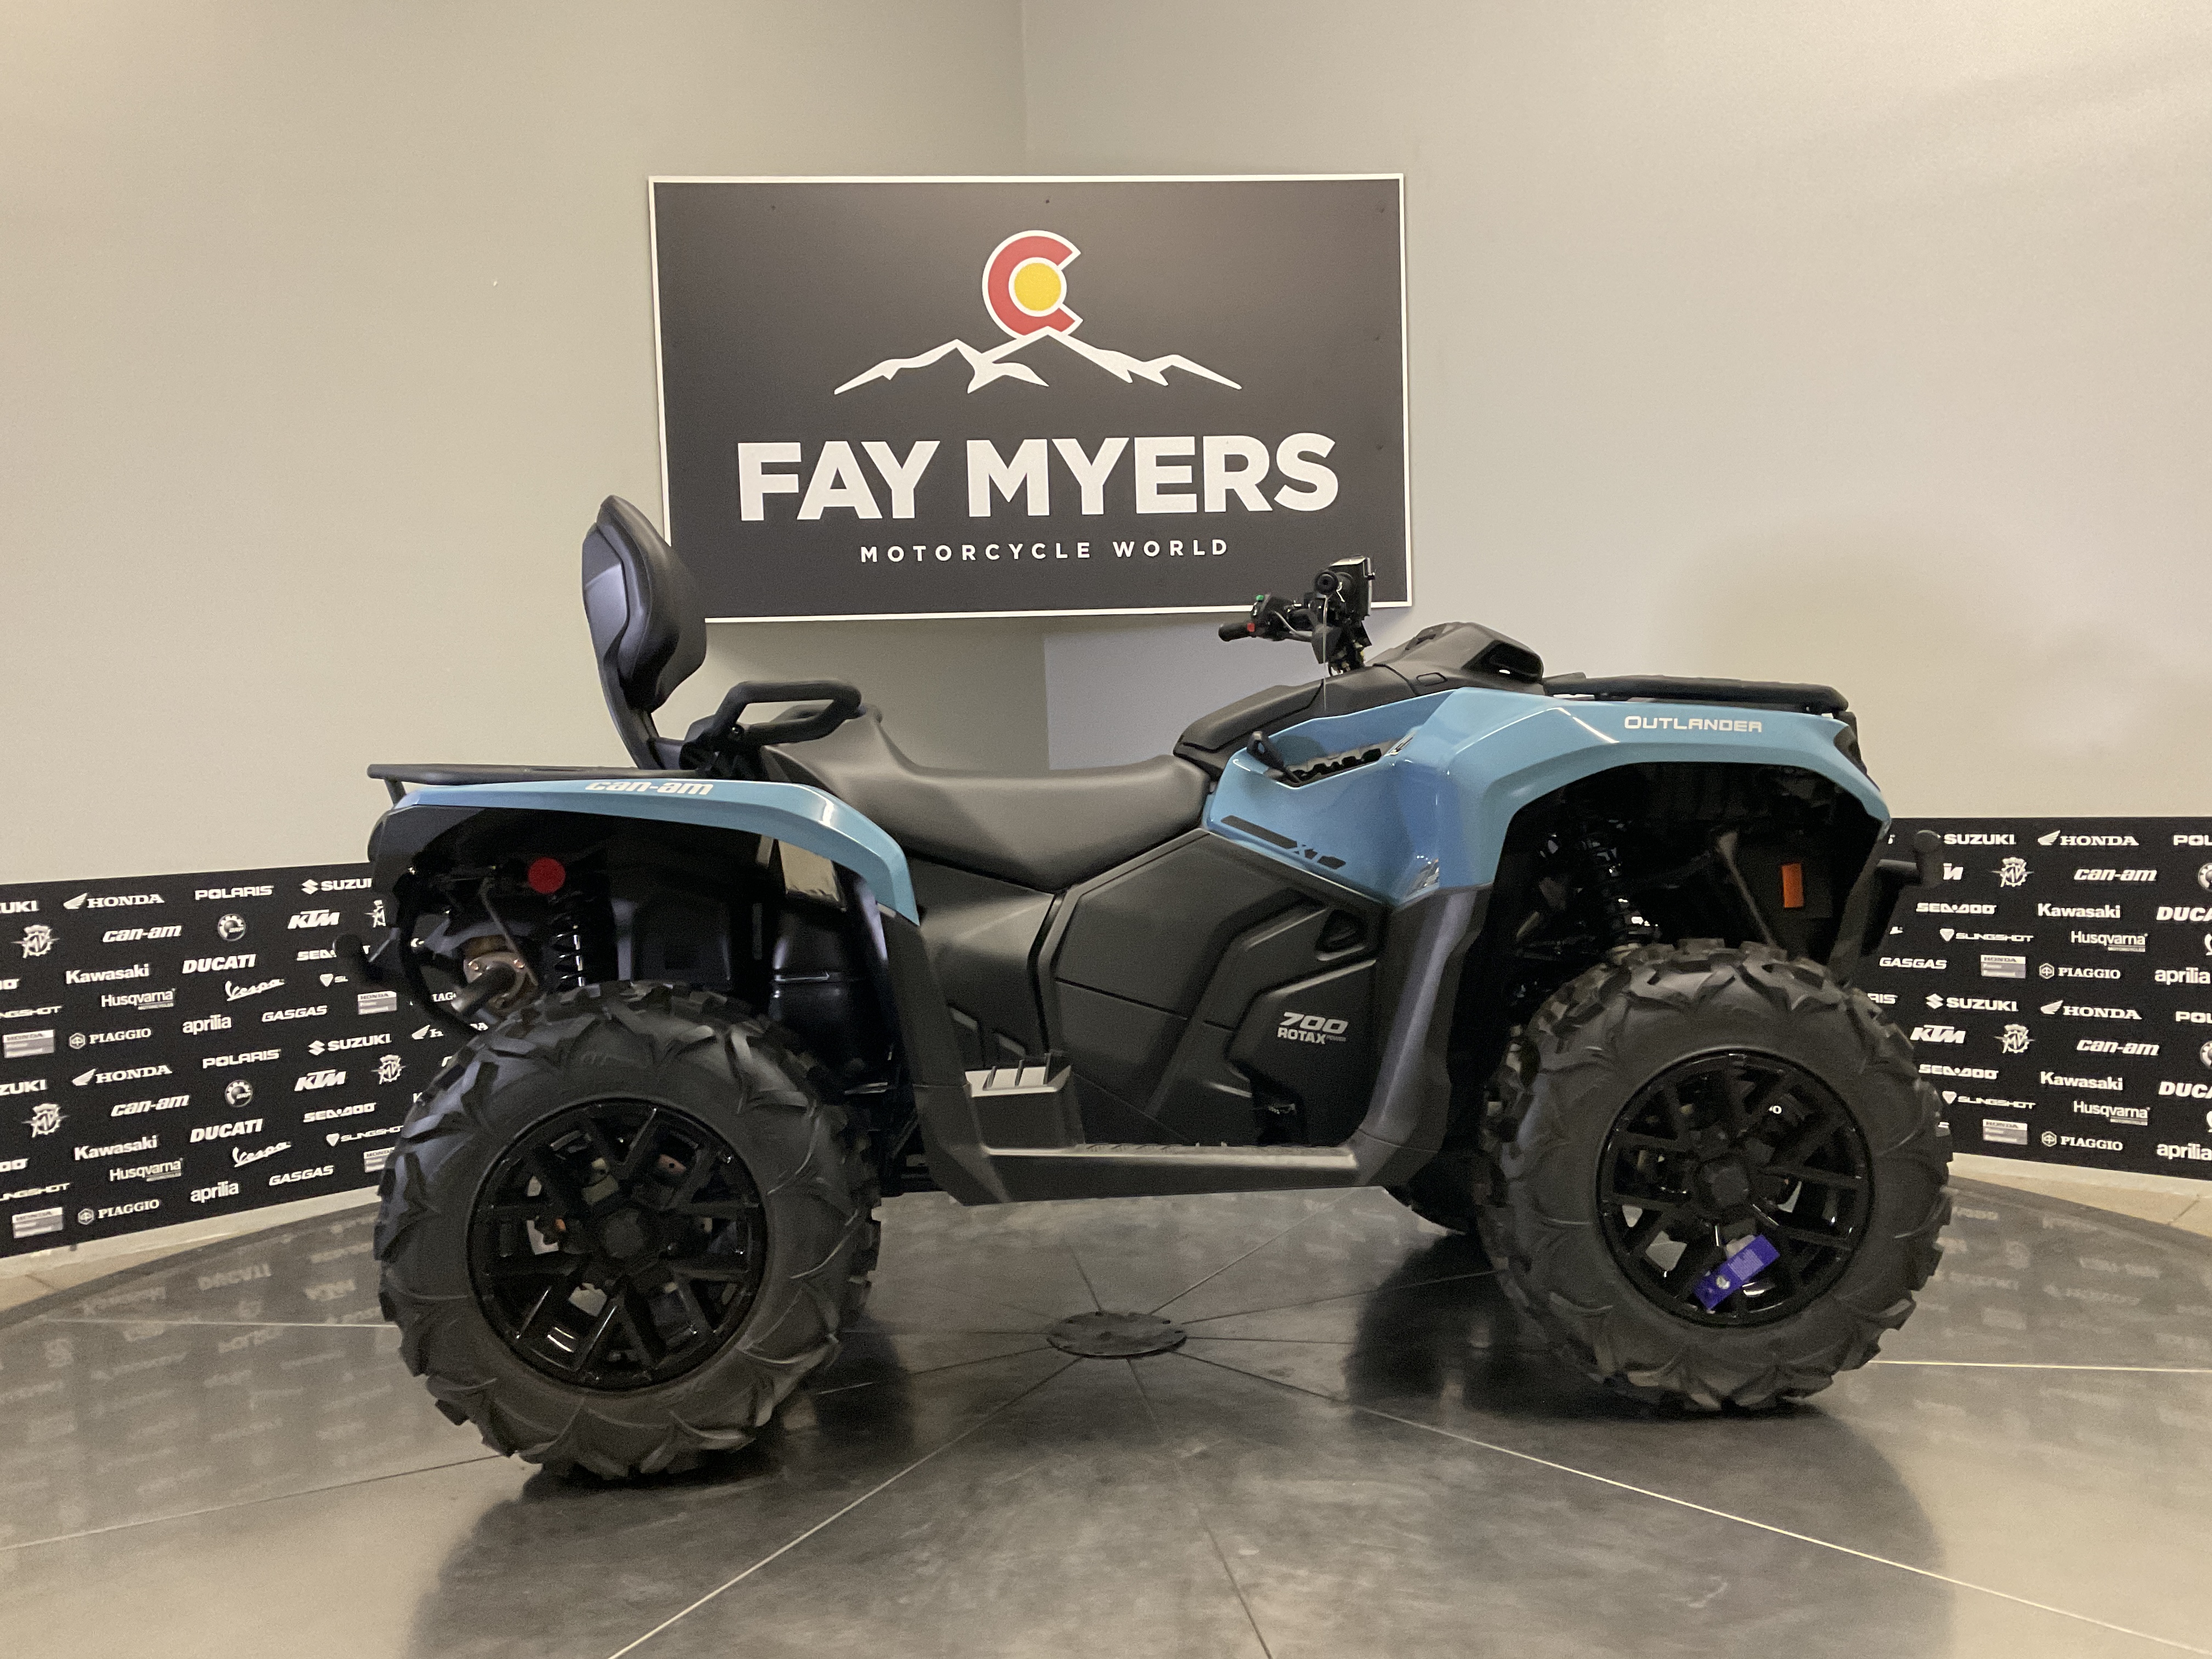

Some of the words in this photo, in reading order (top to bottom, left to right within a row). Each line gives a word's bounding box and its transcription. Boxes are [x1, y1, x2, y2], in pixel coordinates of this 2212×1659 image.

[738, 441, 940, 521] FAY
[967, 433, 1338, 517] MYERS
[861, 543, 1090, 562] MOTORCYCLE
[1113, 539, 1226, 557] WORLD
[585, 782, 713, 795] can-am
[1944, 834, 2016, 844] SUZUKI
[2060, 836, 2139, 845] HONDA
[2074, 869, 2157, 881] can-am
[195, 885, 274, 900] POLARIS
[321, 878, 373, 891] SUZU
[0, 901, 39, 913] UKI
[88, 894, 165, 908] HONDA
[2038, 903, 2120, 918] Kawasaki
[288, 910, 340, 929] KTM
[103, 926, 182, 942] can-am
[1956, 933, 2034, 941] SLINGSHOT
[2070, 930, 2146, 946] Husqvarna
[182, 954, 256, 973] DUCATI
[1880, 957, 1947, 969] GASGAS
[66, 963, 149, 984] Kawasaki
[2058, 968, 2120, 979] PIAGGIO
[2155, 967, 2210, 985] aprilia
[101, 990, 174, 1007] Husqvarna
[1946, 997, 2018, 1011] SUZUKI
[262, 1006, 327, 1022] GASGAS
[2063, 1006, 2142, 1019] HONDA
[183, 1014, 232, 1035] aprilia
[1280, 1012, 1348, 1034] 700
[89, 1028, 151, 1044] PIAGGIO
[328, 1034, 392, 1051] SUZUKI
[1277, 1027, 1325, 1044] ROTAX
[1910, 1025, 1966, 1043] KTM
[2076, 1040, 2159, 1056] can-am
[203, 1049, 281, 1068] POLARIS
[96, 1065, 172, 1083] HONDA
[295, 1069, 346, 1091] KTM
[2041, 1071, 2123, 1090] Kawasaki
[111, 1095, 189, 1116] can-am
[1957, 1096, 2036, 1109] SLINGSHOT
[2073, 1101, 2148, 1118] Husqvarna
[190, 1119, 263, 1142] DUCATI
[75, 1135, 157, 1160] Kawasaki
[2061, 1136, 2123, 1150] PIAGGIO
[2157, 1143, 2212, 1160] aprilia
[109, 1160, 182, 1182] Husqvarna
[269, 1165, 334, 1186] GASGAS
[191, 1181, 239, 1203] aprilia
[98, 1199, 159, 1218] PIAGGIO
